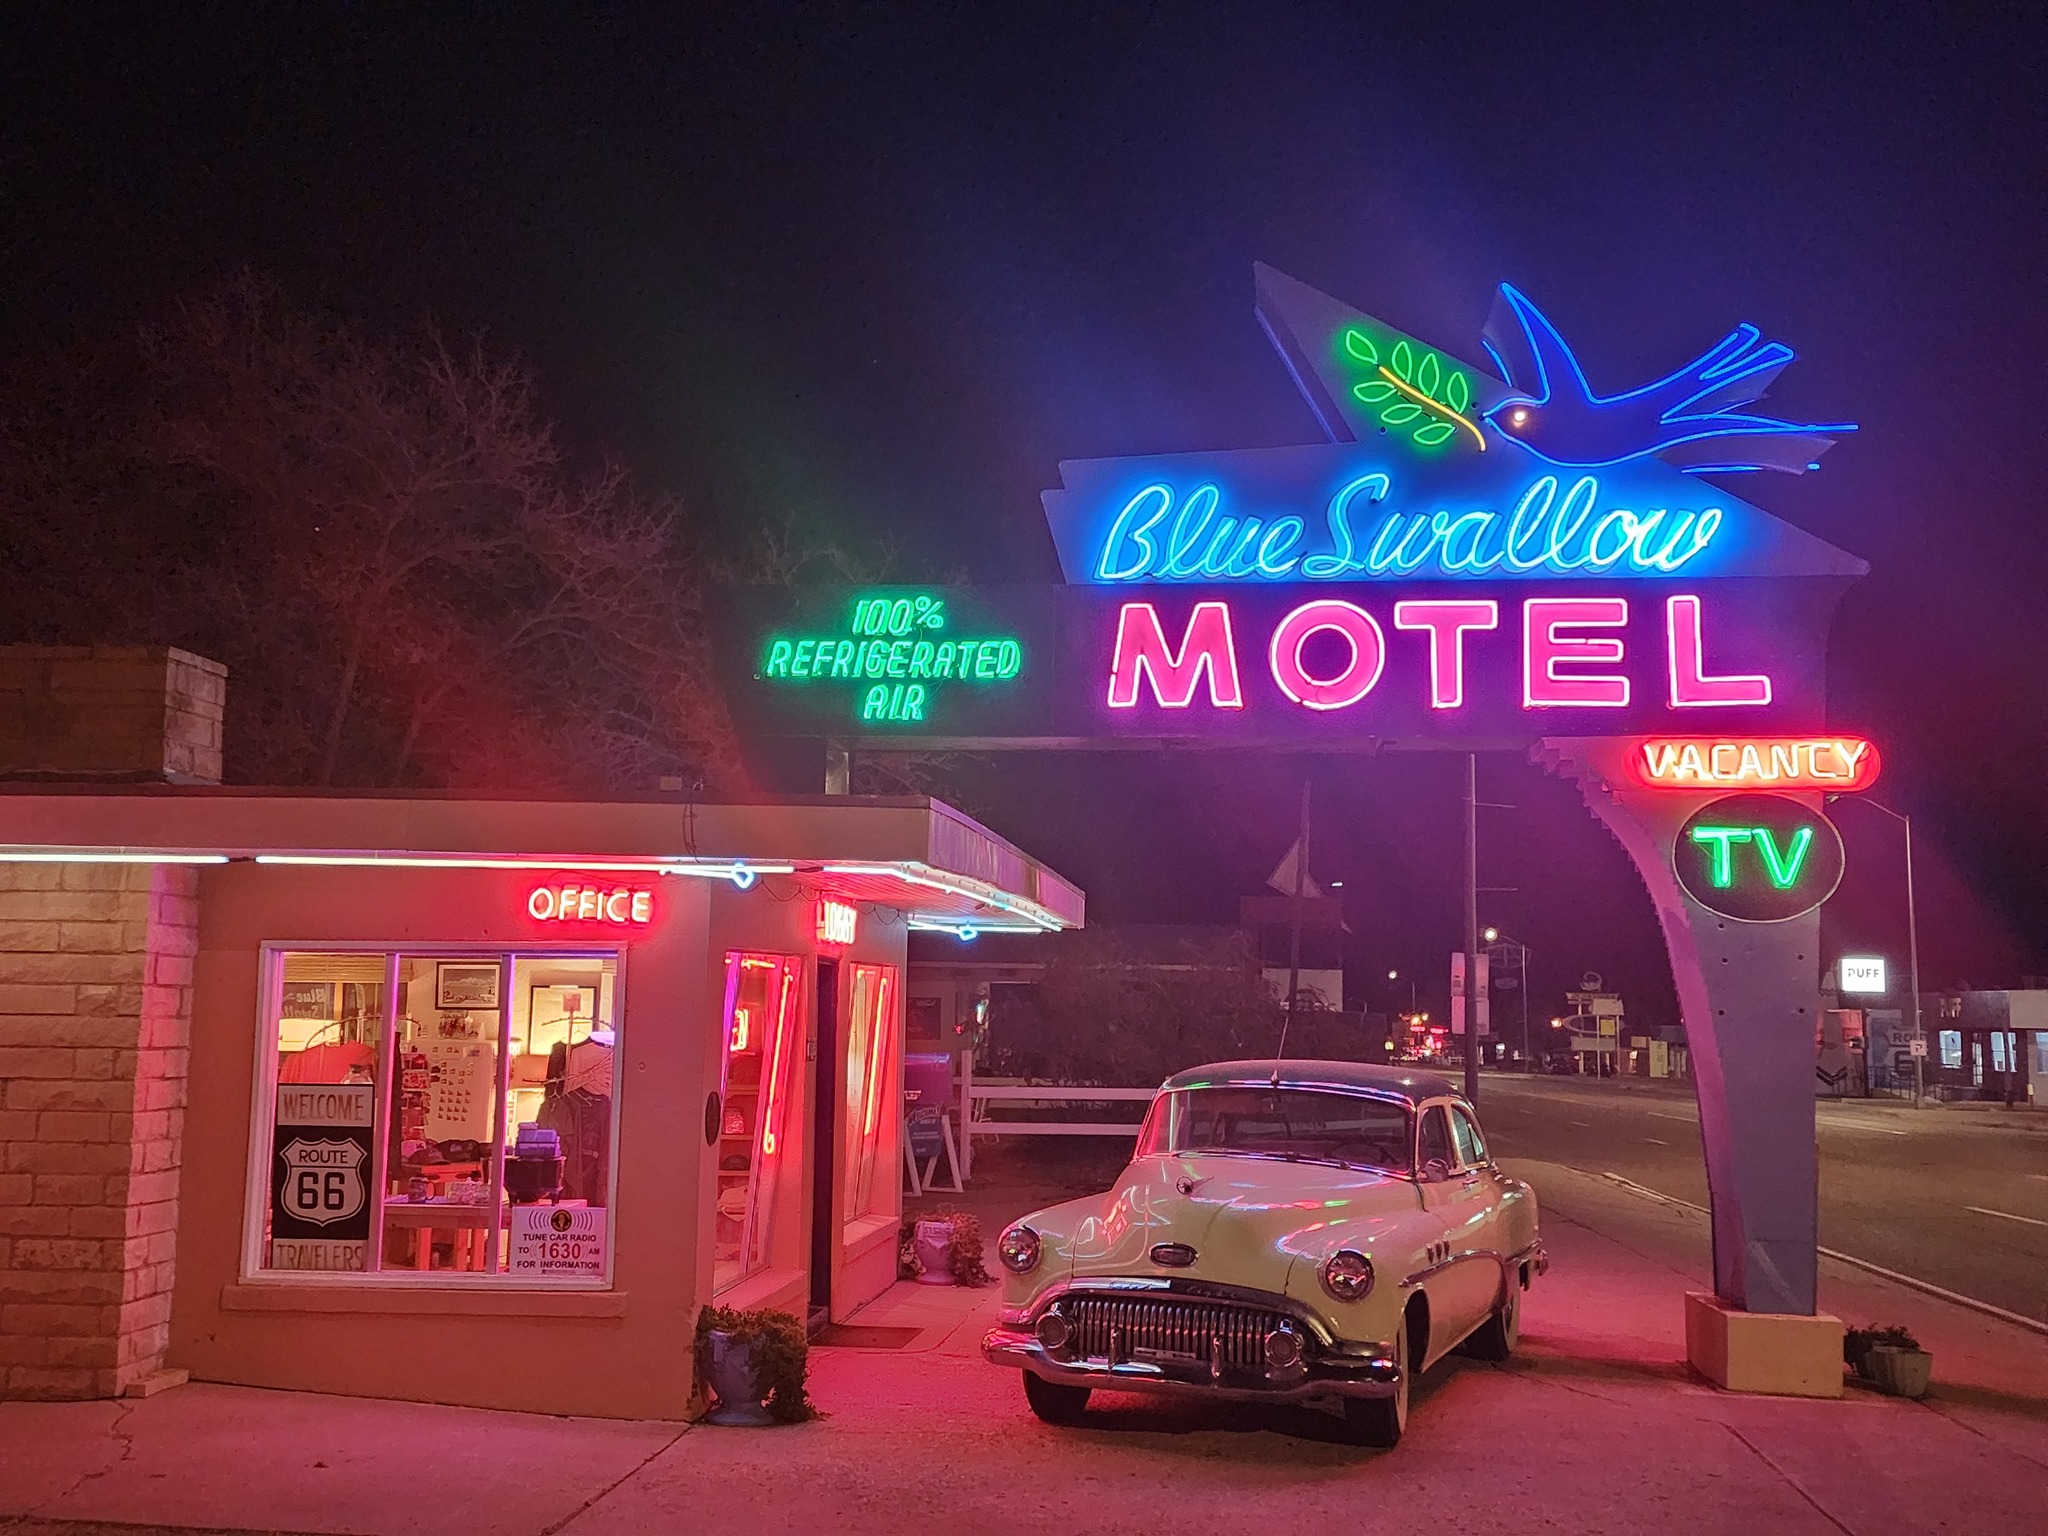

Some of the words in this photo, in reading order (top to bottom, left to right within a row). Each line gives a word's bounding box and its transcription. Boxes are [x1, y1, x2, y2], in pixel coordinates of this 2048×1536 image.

[1094, 484, 1305, 580] Blue
[1301, 474, 1723, 576] Swallow
[852, 596, 945, 636] 100%
[766, 640, 1021, 679] REFRIGERATED
[1108, 595, 1772, 710] MOTEL
[863, 684, 925, 721] AIR
[1643, 740, 1868, 780] VACANCY
[1692, 826, 1813, 889] TV
[528, 887, 650, 923] OFFICE
[1847, 968, 1880, 978] PUFF
[284, 1093, 364, 1121] WELCOME
[299, 1149, 348, 1164] ROUTE
[297, 1171, 345, 1211] 66
[523, 1233, 547, 1241] TUNE
[549, 1233, 568, 1241] CAR
[570, 1234, 596, 1242] RADIO
[538, 1242, 581, 1259] 1630
[277, 1244, 364, 1271] TRAVELERS
[516, 1260, 536, 1268] FOR
[540, 1260, 600, 1269] INFORMATION
